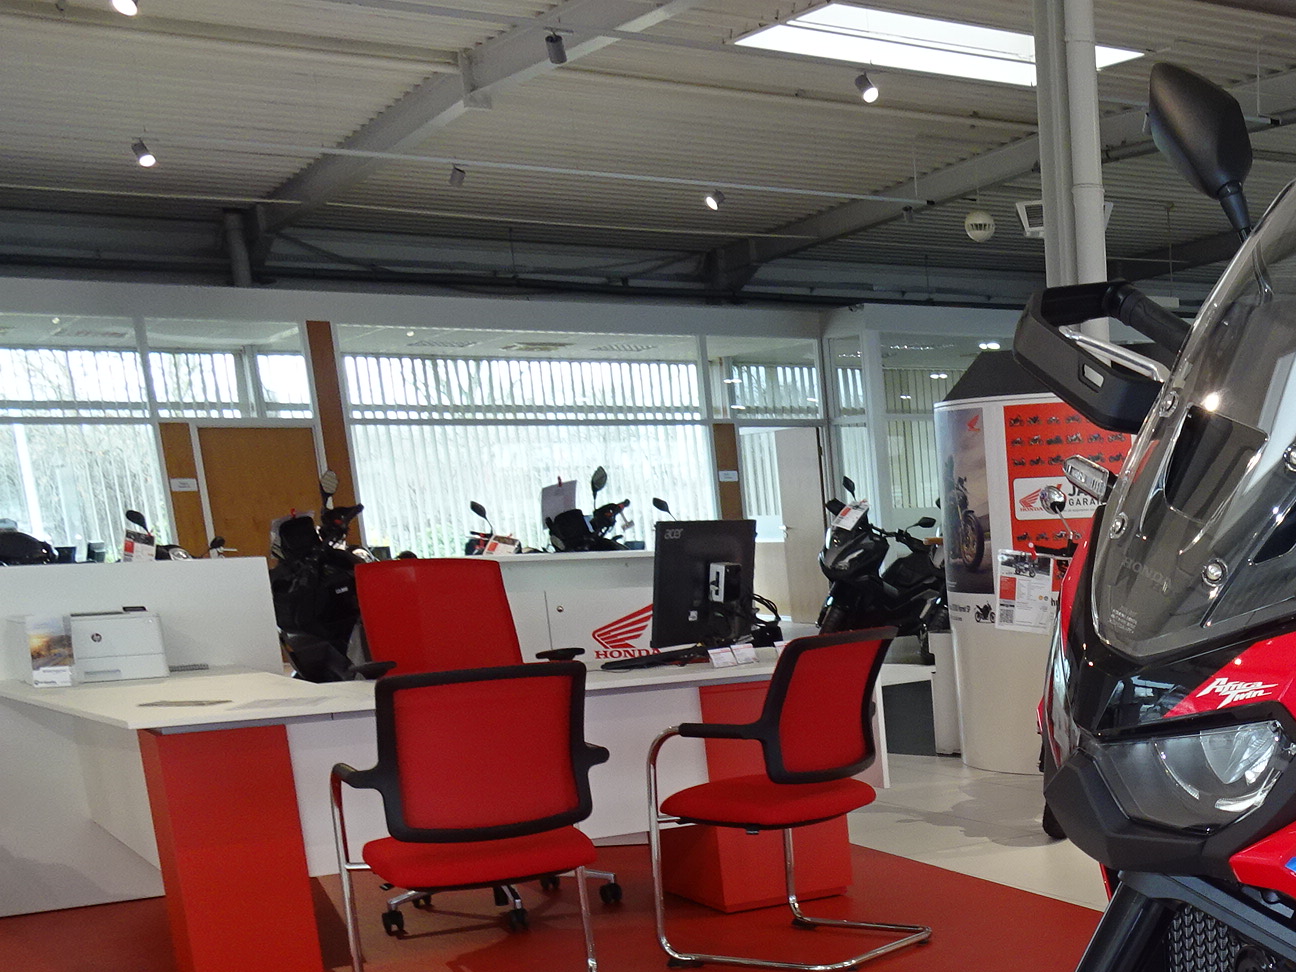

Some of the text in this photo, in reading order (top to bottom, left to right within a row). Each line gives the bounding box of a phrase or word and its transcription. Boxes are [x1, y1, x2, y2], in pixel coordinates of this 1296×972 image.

[664, 528, 683, 539] acer
[1196, 677, 1279, 698] Africa
[1216, 689, 1273, 710] Twin
